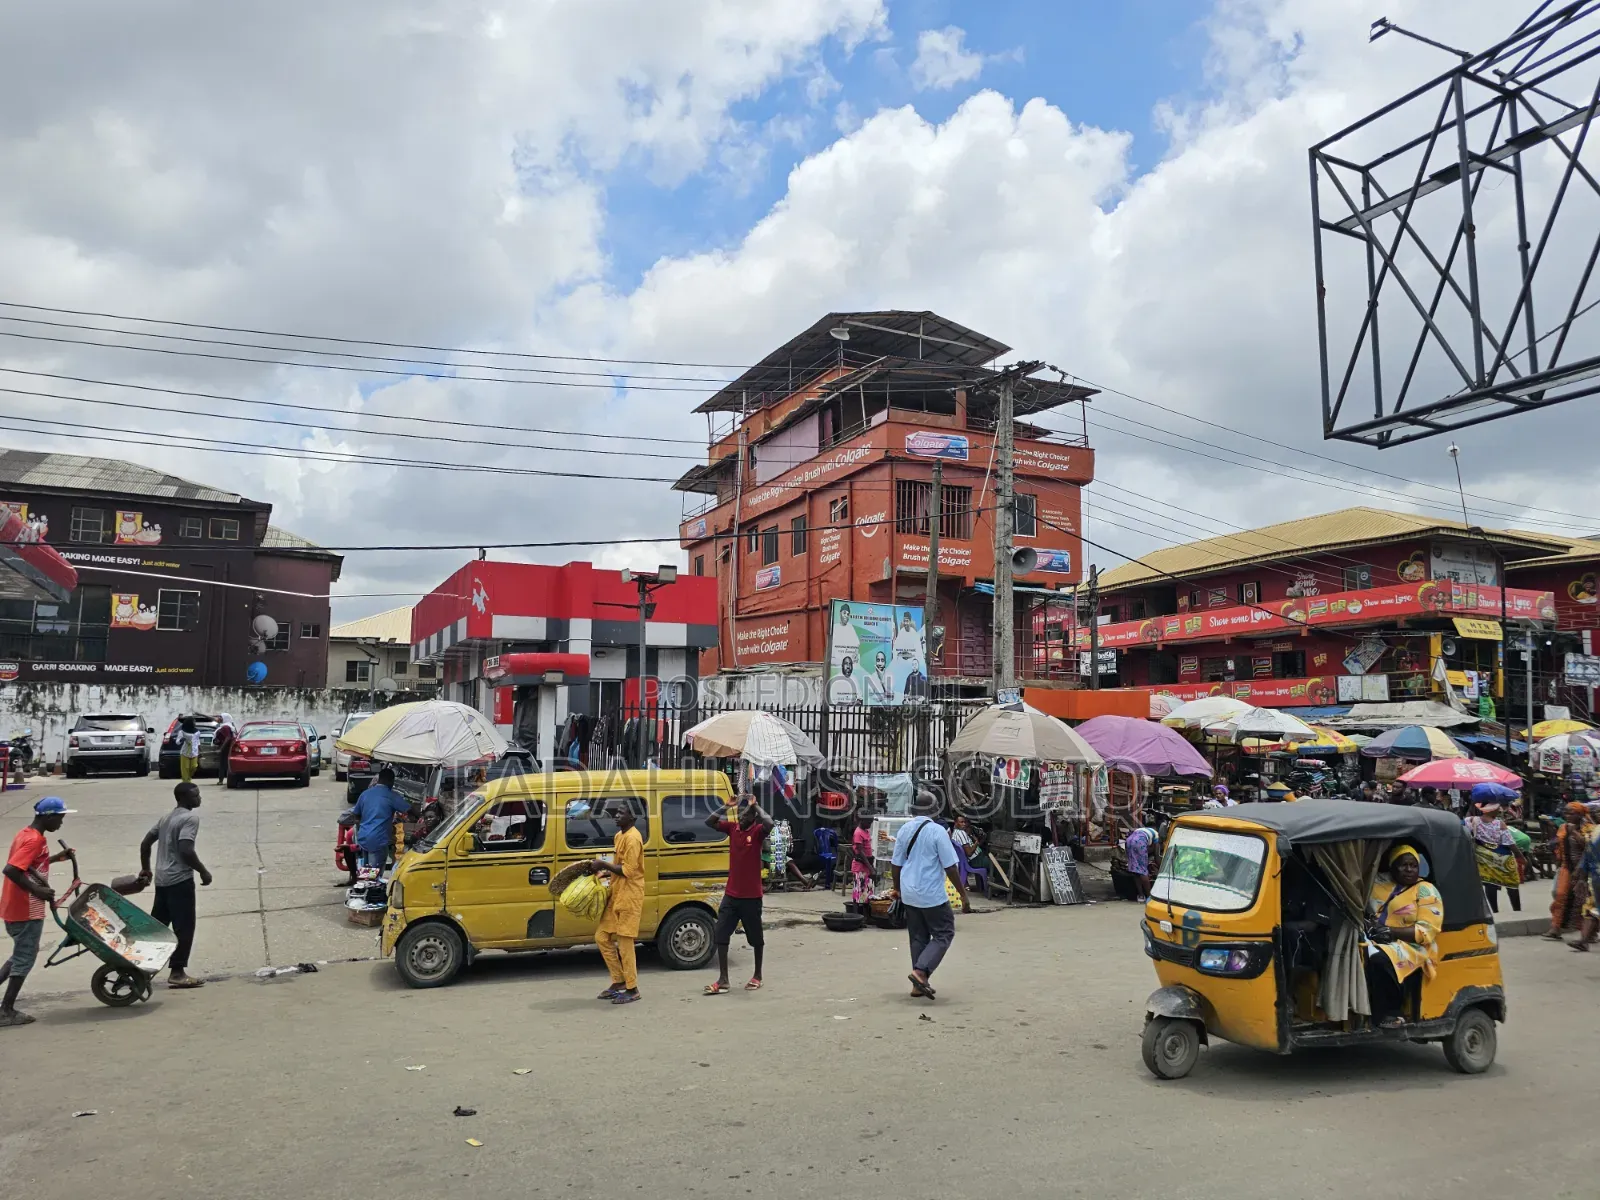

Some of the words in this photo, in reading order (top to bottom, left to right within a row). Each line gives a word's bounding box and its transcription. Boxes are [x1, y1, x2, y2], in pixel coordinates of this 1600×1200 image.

[909, 438, 945, 449] Colgate
[1033, 451, 1049, 459] Right
[1049, 453, 1070, 461] Choice!
[1037, 460, 1069, 471] Colgate
[749, 494, 761, 505] Make
[761, 490, 771, 500] the
[771, 483, 784, 498] Right
[804, 467, 820, 482] Brush
[820, 460, 835, 474] with
[835, 443, 871, 468] Colgate
[855, 511, 886, 529] Colgate
[903, 543, 920, 551] Make
[921, 544, 930, 552] the
[938, 547, 948, 556] ght
[949, 547, 971, 556] Choice!
[58, 551, 90, 562] OAKING
[92, 554, 116, 563] MADE
[117, 556, 140, 566] EASY!
[820, 551, 841, 563] Colgate
[903, 553, 920, 561] Brush
[937, 555, 971, 566] Colgate
[1364, 599, 1379, 607] Show
[1478, 594, 1496, 607] Show
[1209, 616, 1228, 628] Show
[1231, 615, 1250, 624] some
[737, 630, 749, 640] Make
[749, 629, 757, 639] the
[757, 627, 770, 640] Right
[770, 624, 789, 636] Choice!
[750, 643, 760, 653] with
[760, 640, 788, 655] Colgate
[32, 663, 57, 671] GARRI
[58, 664, 96, 672] SOAKING
[104, 664, 128, 672] MADE
[129, 665, 153, 673] EASY!
[993, 757, 1030, 782] POS
[1047, 762, 1068, 772] POS
